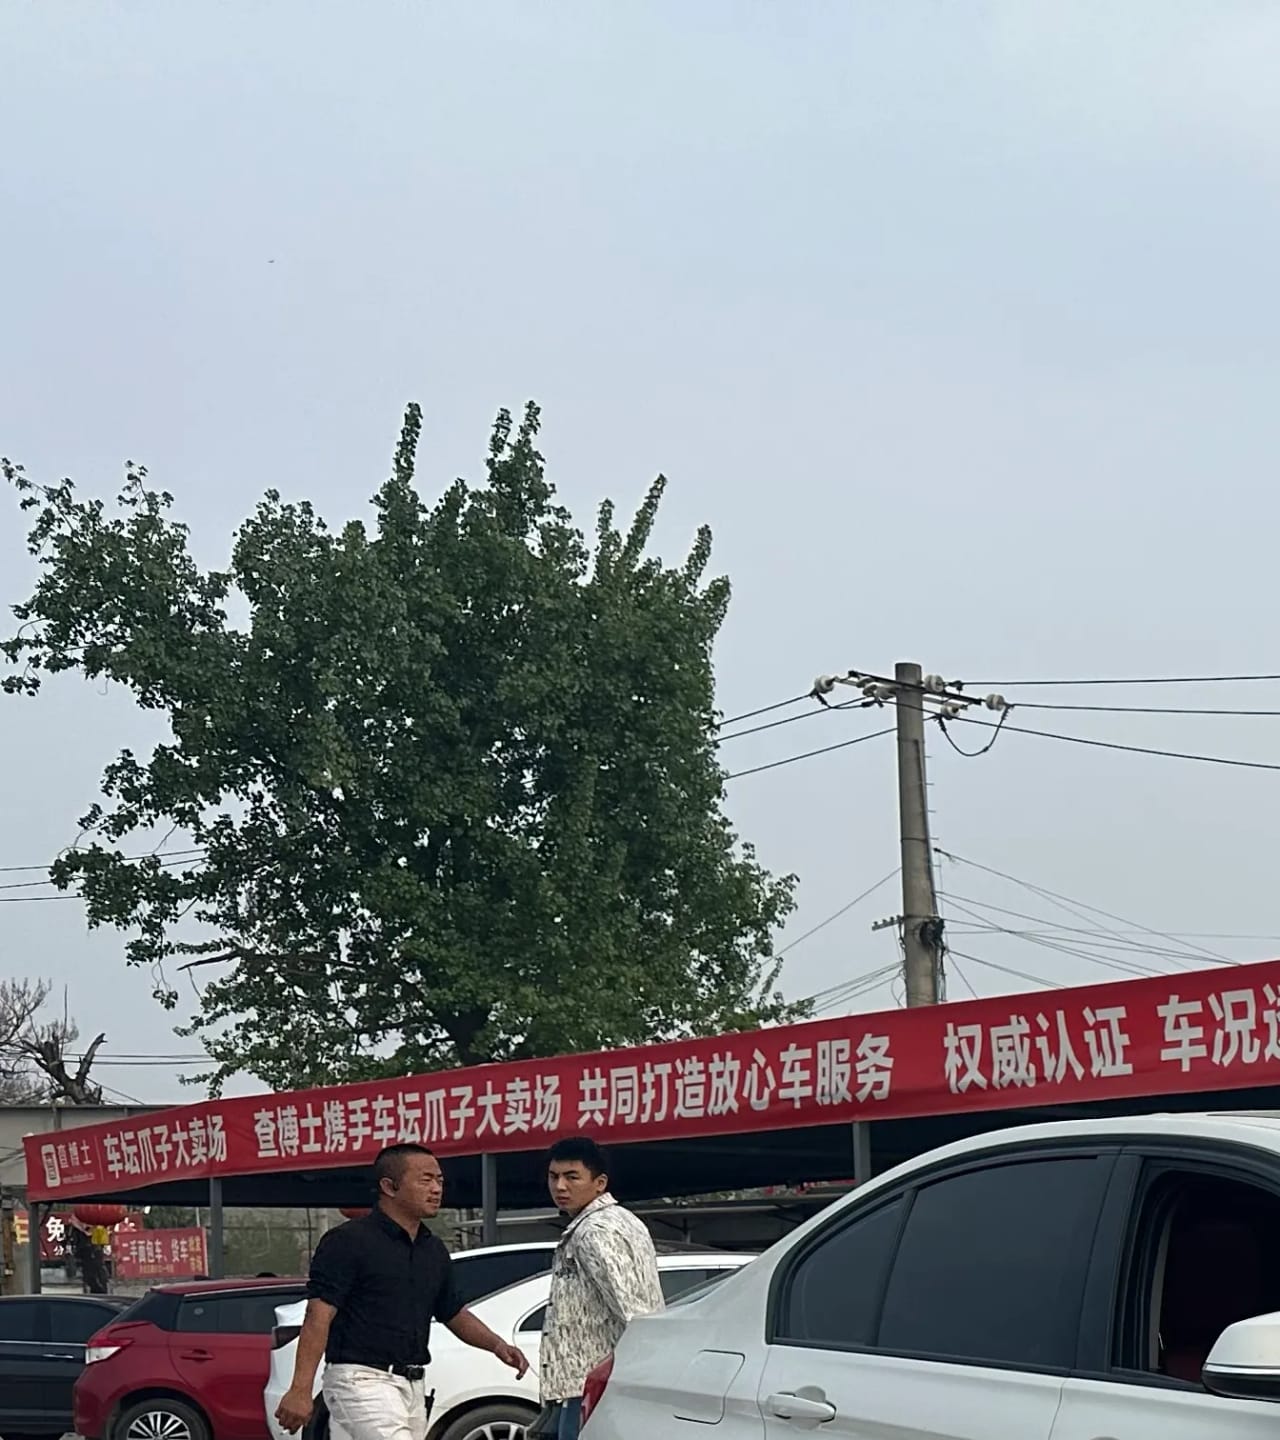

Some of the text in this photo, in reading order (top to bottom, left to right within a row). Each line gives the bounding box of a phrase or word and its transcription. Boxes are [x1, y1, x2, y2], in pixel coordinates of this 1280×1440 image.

[103, 1114, 227, 1179] 车坛爪子大卖场
[253, 1075, 561, 1159] 查博士携手车坛爪子大卖场
[578, 1033, 894, 1129] 共同打造放心车服务
[943, 1004, 1133, 1094] 权威认证
